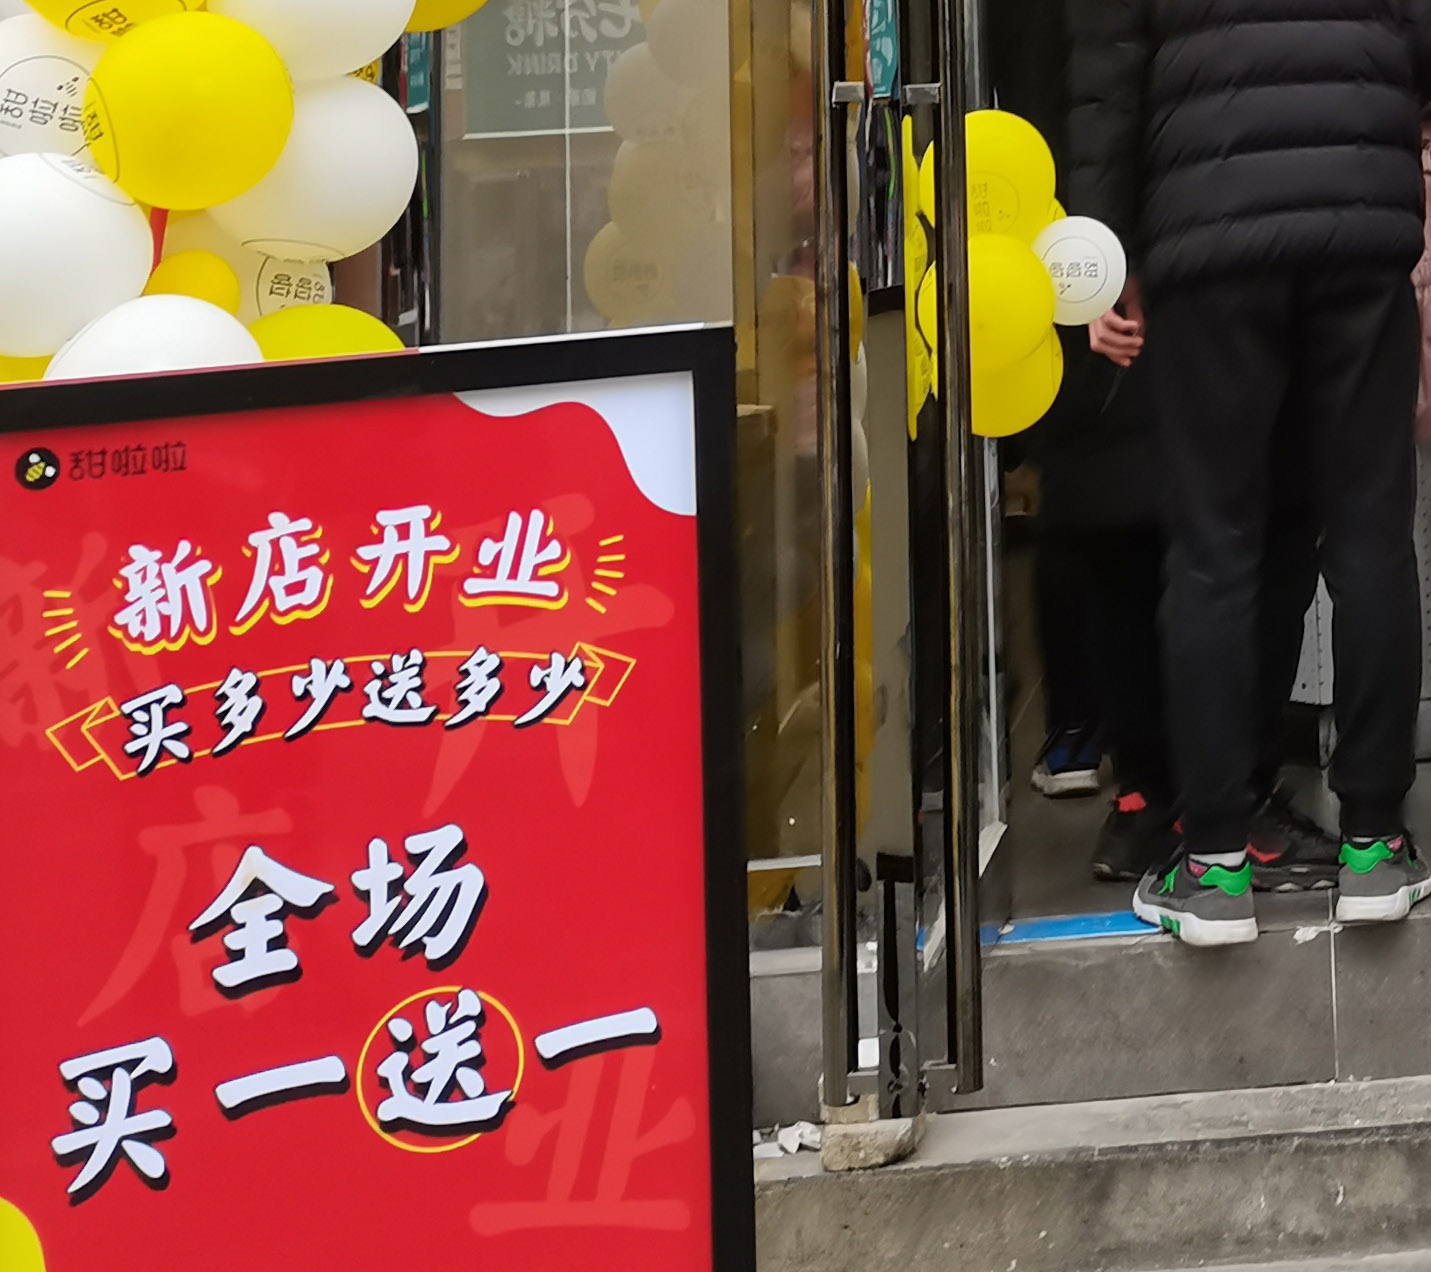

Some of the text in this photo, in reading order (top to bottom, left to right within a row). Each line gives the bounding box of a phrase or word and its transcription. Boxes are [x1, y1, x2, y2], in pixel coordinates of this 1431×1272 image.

[68, 441, 188, 481] 甜啦啦
[110, 503, 568, 652] 新店开业
[120, 646, 587, 776] 买多少送多少
[188, 823, 488, 996] 全场
[50, 987, 661, 1206] 买一送一
